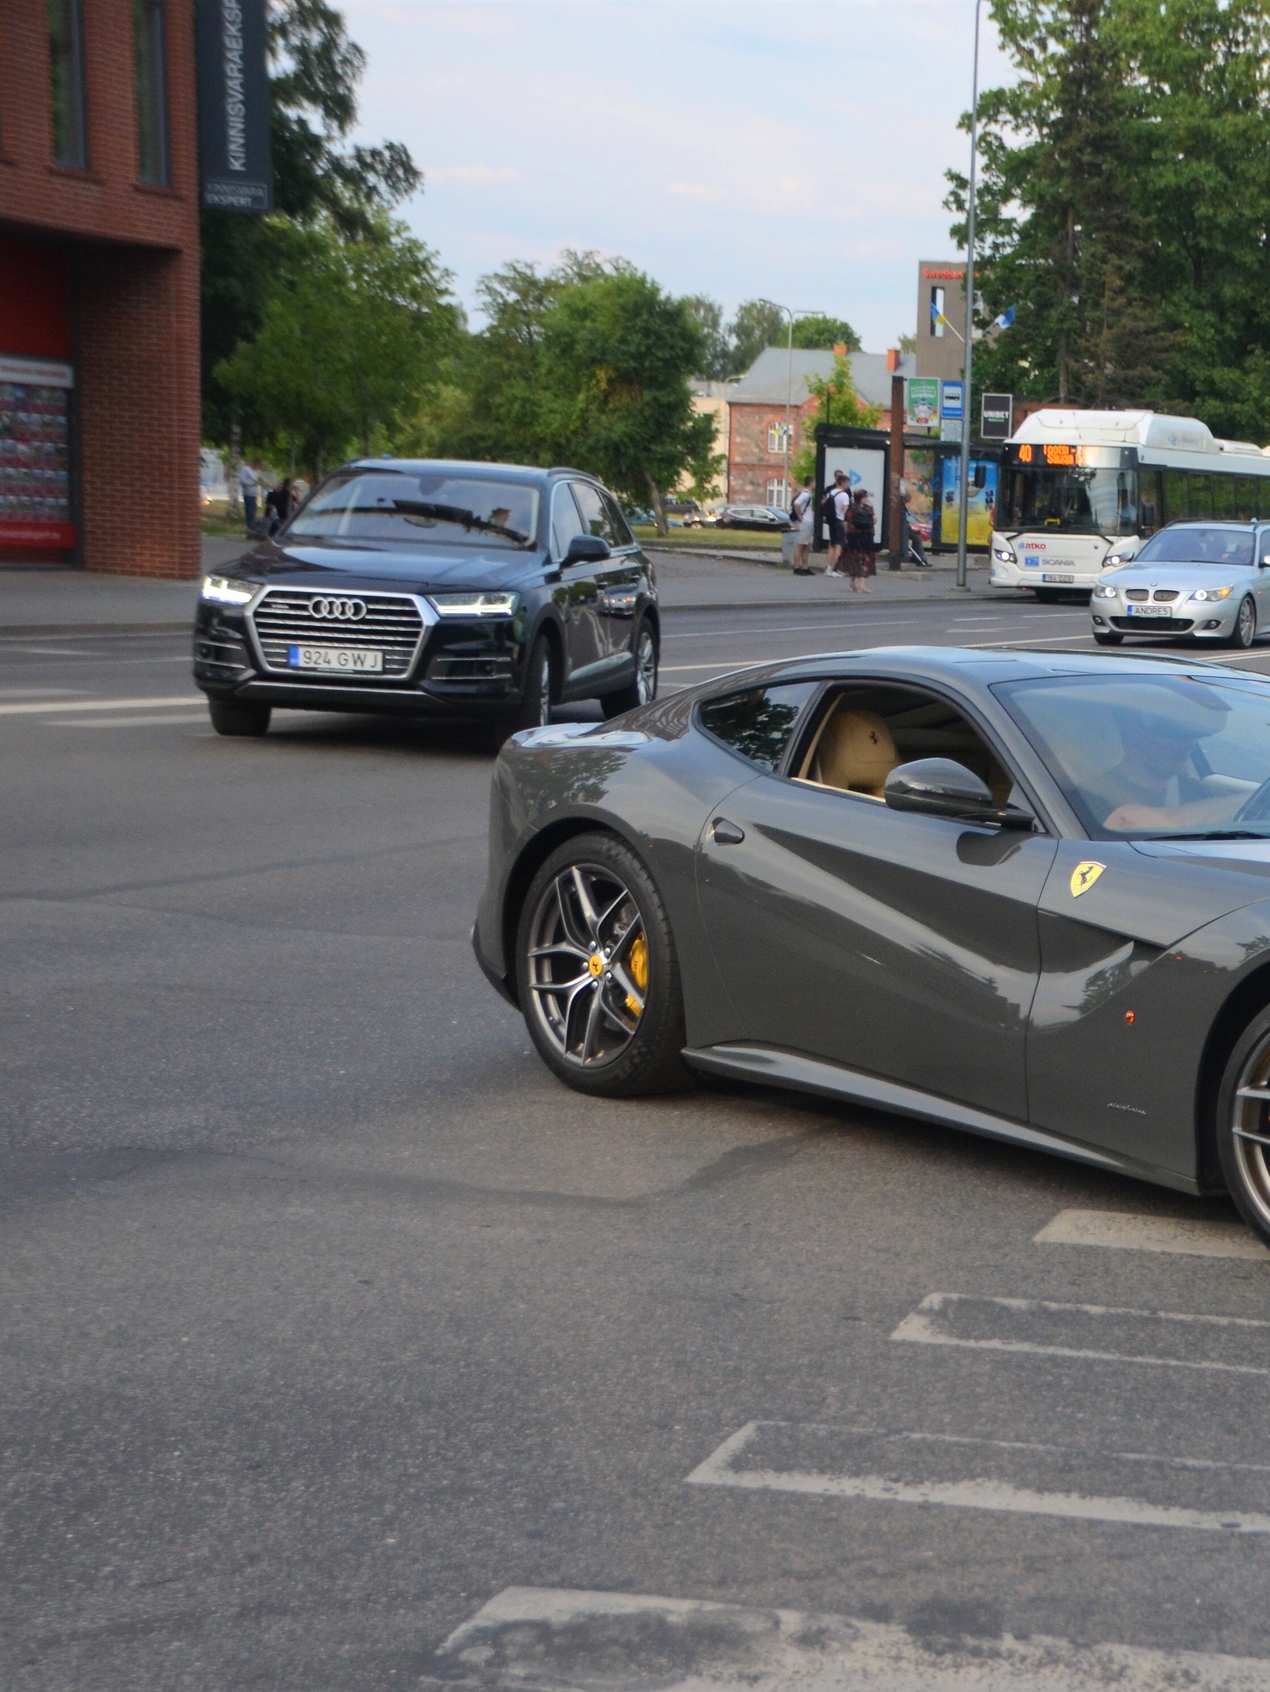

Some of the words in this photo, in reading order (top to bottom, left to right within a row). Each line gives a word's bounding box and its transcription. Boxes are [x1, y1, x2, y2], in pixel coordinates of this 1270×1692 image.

[922, 267, 965, 279] Swedban
[1019, 444, 1033, 463] 40
[1041, 559, 1076, 567] SCANIA
[1134, 607, 1168, 616] ANDRES
[303, 650, 332, 666] 924
[337, 652, 378, 668] GWJ
